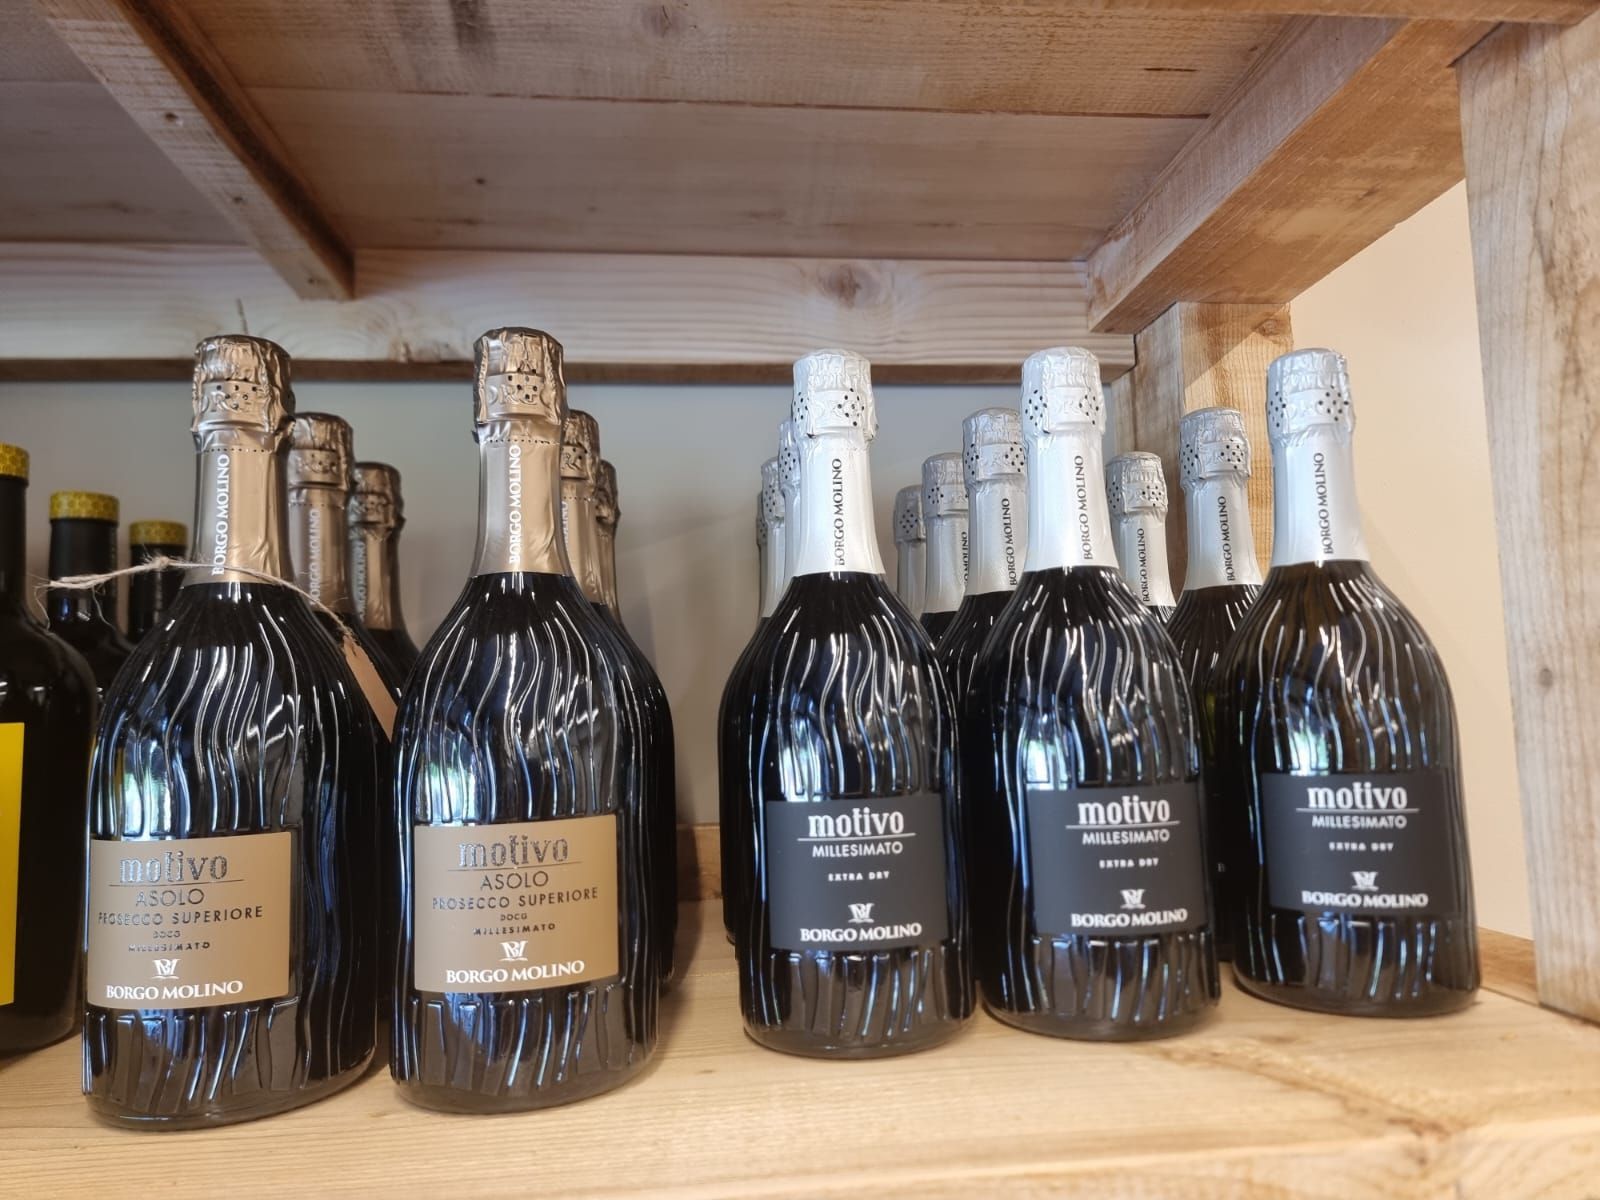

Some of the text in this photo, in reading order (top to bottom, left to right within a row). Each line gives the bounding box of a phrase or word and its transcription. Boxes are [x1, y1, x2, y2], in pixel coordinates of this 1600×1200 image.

[509, 444, 522, 564] BORGO MOLINO
[831, 458, 845, 566] BORGO MOLINO
[1074, 455, 1094, 560] BORGO MOLINO
[1313, 452, 1334, 554] BORGO MOLINO
[212, 454, 230, 576] BORGO MOLINO
[309, 508, 320, 560] MOLINO
[1001, 498, 1017, 586] BORGO MOLINO
[1217, 495, 1236, 581] BORGO MOLINO
[1136, 528, 1151, 602] BORGO MOLINO
[1307, 782, 1408, 809] motivo
[1078, 795, 1170, 825] motivo
[808, 806, 905, 838] motivo
[1311, 815, 1407, 829] MILLESIMATO
[1082, 829, 1170, 845] MILLESIMATO
[1329, 842, 1366, 851] EXTRA
[457, 834, 568, 867] motivo
[812, 841, 903, 858] MILLESIMATO
[120, 850, 228, 884] motivo
[1099, 858, 1159, 868] EXTRA DRY
[480, 870, 549, 891] ASOLO
[828, 871, 890, 882] EXTRA DRY
[135, 888, 205, 907] ASOLO
[432, 887, 598, 910] PROSECCO SUPERIORE
[1301, 890, 1429, 908] BORGO MOLINO
[172, 905, 263, 925] SUPERIORE
[500, 913, 528, 921] DOCG
[1070, 908, 1188, 928] BORGO MOLINO
[473, 923, 556, 935] MILLESIMATO
[800, 922, 922, 942] BORGO MOLINO
[446, 960, 585, 984] BORGO MOLINO
[106, 980, 244, 1000] BORGO MOLINO
